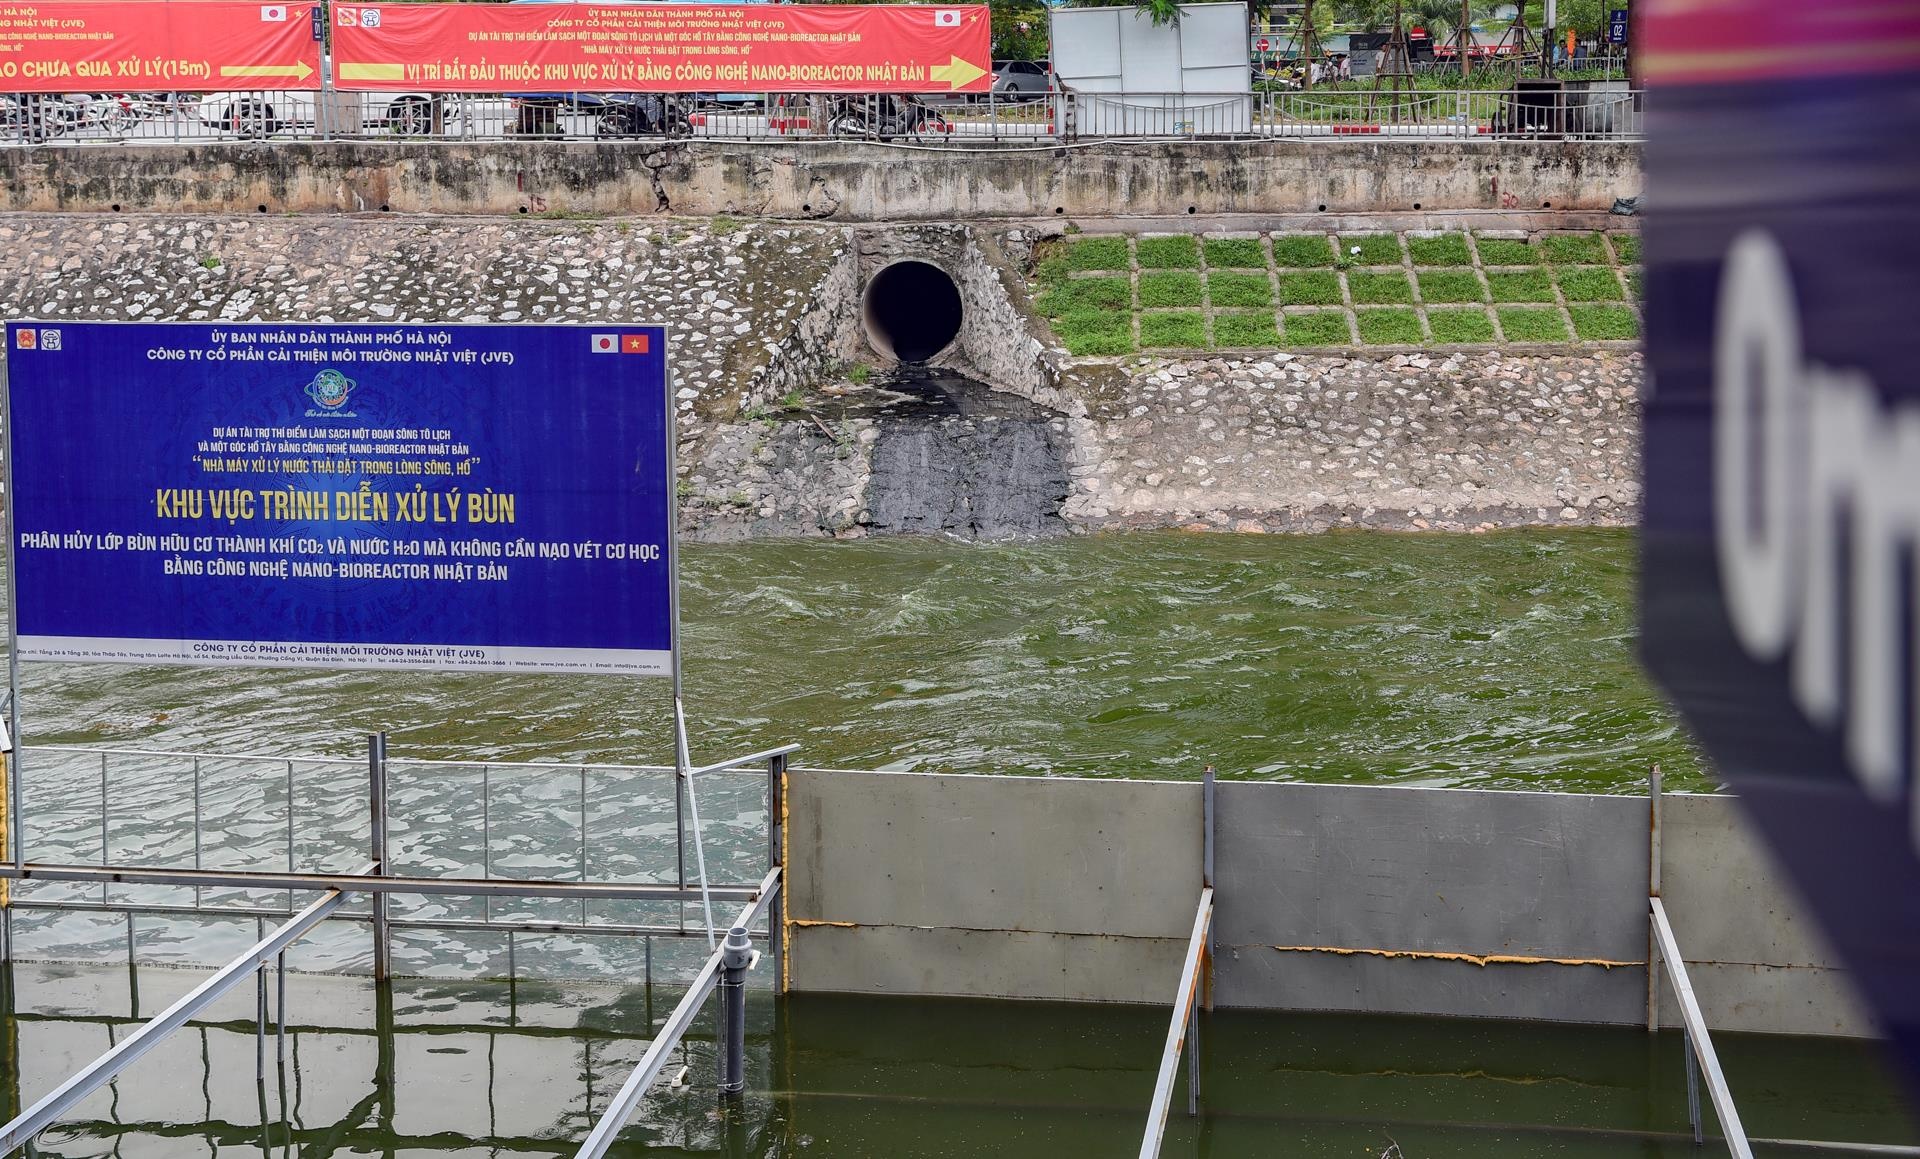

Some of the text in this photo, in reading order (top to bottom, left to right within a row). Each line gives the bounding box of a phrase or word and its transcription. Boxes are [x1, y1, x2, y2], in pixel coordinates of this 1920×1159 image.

[4, 7, 37, 17] HÀ NỘI
[588, 8, 599, 19] ỦY
[621, 9, 644, 18] NHÂN
[646, 9, 664, 18] DÂN
[666, 10, 693, 18] THÀNH
[696, 8, 713, 18] PHỐ
[715, 10, 727, 18] HÀ
[729, 9, 744, 19] NỘI
[14, 18, 38, 28] NHẬT
[41, 18, 58, 28] VIỆT
[61, 20, 85, 28] (JVE)
[547, 18, 573, 28] CÔNG
[586, 18, 600, 27] CỔ
[602, 18, 624, 28] PHẦN
[627, 19, 642, 28] CẢI
[644, 19, 666, 29] THIỆN
[668, 20, 685, 28] MÔI
[687, 19, 720, 28] TRƯỜNG
[722, 18, 743, 29] NHẬT
[746, 19, 761, 29] VIỆT
[764, 21, 785, 29] (JVE)
[1613, 25, 1623, 36] 02
[22, 59, 71, 78] CHƯA
[76, 60, 112, 77] QUA
[118, 54, 141, 77] XỬ
[145, 55, 211, 80] LÝ(15m)
[408, 57, 925, 85] VỊ TRÍ BẮT ĐẦU THUỘC KHU VỰC XỬ LÝ BẰNG CÔNG NGHỆ NANO-BIOREACTOR NHẬT BẢN
[212, 329, 451, 345] ỦY BAN NHÂN DÂN THÀNH PHỐ HÀ NỘI
[147, 345, 514, 365] CÔNG TY CỔ PHẦN CẢI THIỆN MÔI TRƯỜNG NHẬT VIỆT (JVE)
[213, 426, 451, 442] DỰ ÁN TÀI TRỢ THÍ ĐIỂM LÀM SẠCH MỘT ĐOẠN SÔNG TÔ LỊCH
[198, 441, 469, 457] VÀ MỘT GÓC HỒ TÂY BẰNG CÔNG NGHỆ NANO-BIOREACTOR NHẬT BẢN
[227, 457, 249, 472] MÁY
[252, 456, 265, 473] XỬ
[268, 457, 280, 473] LÝ
[283, 458, 309, 474] NƯỚC
[312, 458, 335, 475] THẢI
[337, 459, 358, 476] ĐẶT
[360, 461, 393, 475] TRONG
[396, 459, 422, 475] LÒNG
[424, 459, 454, 477] SÔNG,
[157, 480, 514, 526] KHU VỰC TRÌNH DIỄN XỬ LÝ BÙN
[21, 530, 60, 549] PHÂN
[64, 530, 92, 550] HỦY
[97, 532, 123, 550] LỚP
[127, 533, 156, 551] BÙN
[161, 532, 189, 552] HỮU
[194, 536, 212, 552] CƠ
[216, 534, 265, 553] THÀNH
[270, 535, 294, 554] KHÍ
[327, 536, 346, 555] VÀ
[350, 536, 389, 555] NƯỚC
[424, 537, 447, 556] MÀ
[451, 538, 501, 557] KHÔNG
[505, 537, 535, 558] CẦN
[540, 542, 570, 561] NẠO
[574, 540, 601, 559] VÉT
[606, 543, 625, 559] CƠ
[629, 544, 659, 563] HỌC
[164, 554, 507, 582] BẰNG CÔNG NGHỆ NANO-BIOREACTOR NHẬT BẢN
[194, 641, 485, 659] CÔNG TY CỔ PHẦN CẢI THIỆN MÔI TRƯỜNG NHẬT VIỆT (JVE)
